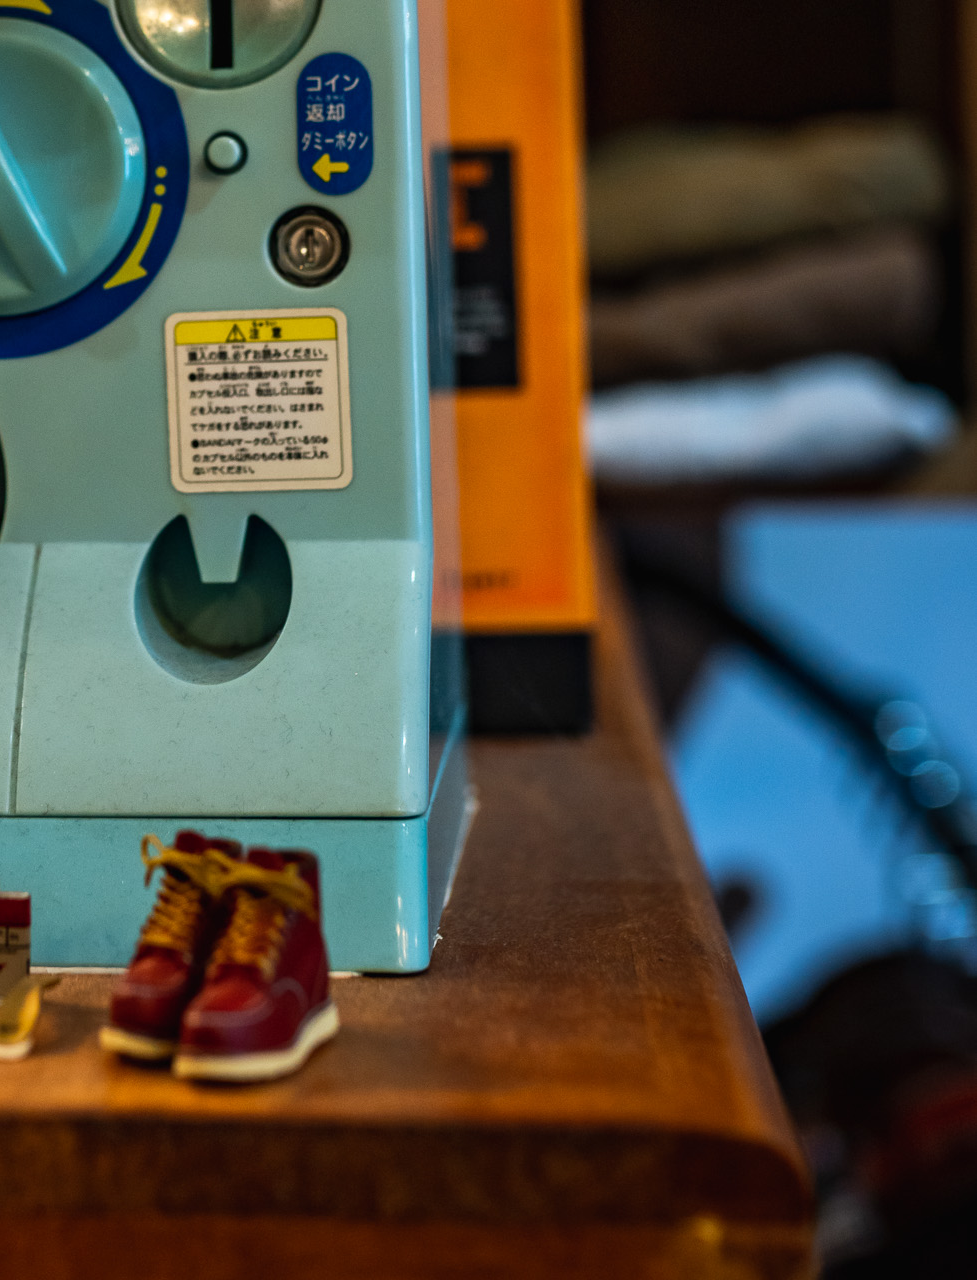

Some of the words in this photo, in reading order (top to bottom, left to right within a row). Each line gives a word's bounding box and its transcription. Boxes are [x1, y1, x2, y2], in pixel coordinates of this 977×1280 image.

[306, 73, 359, 92] コイン
[305, 103, 345, 122] 返却
